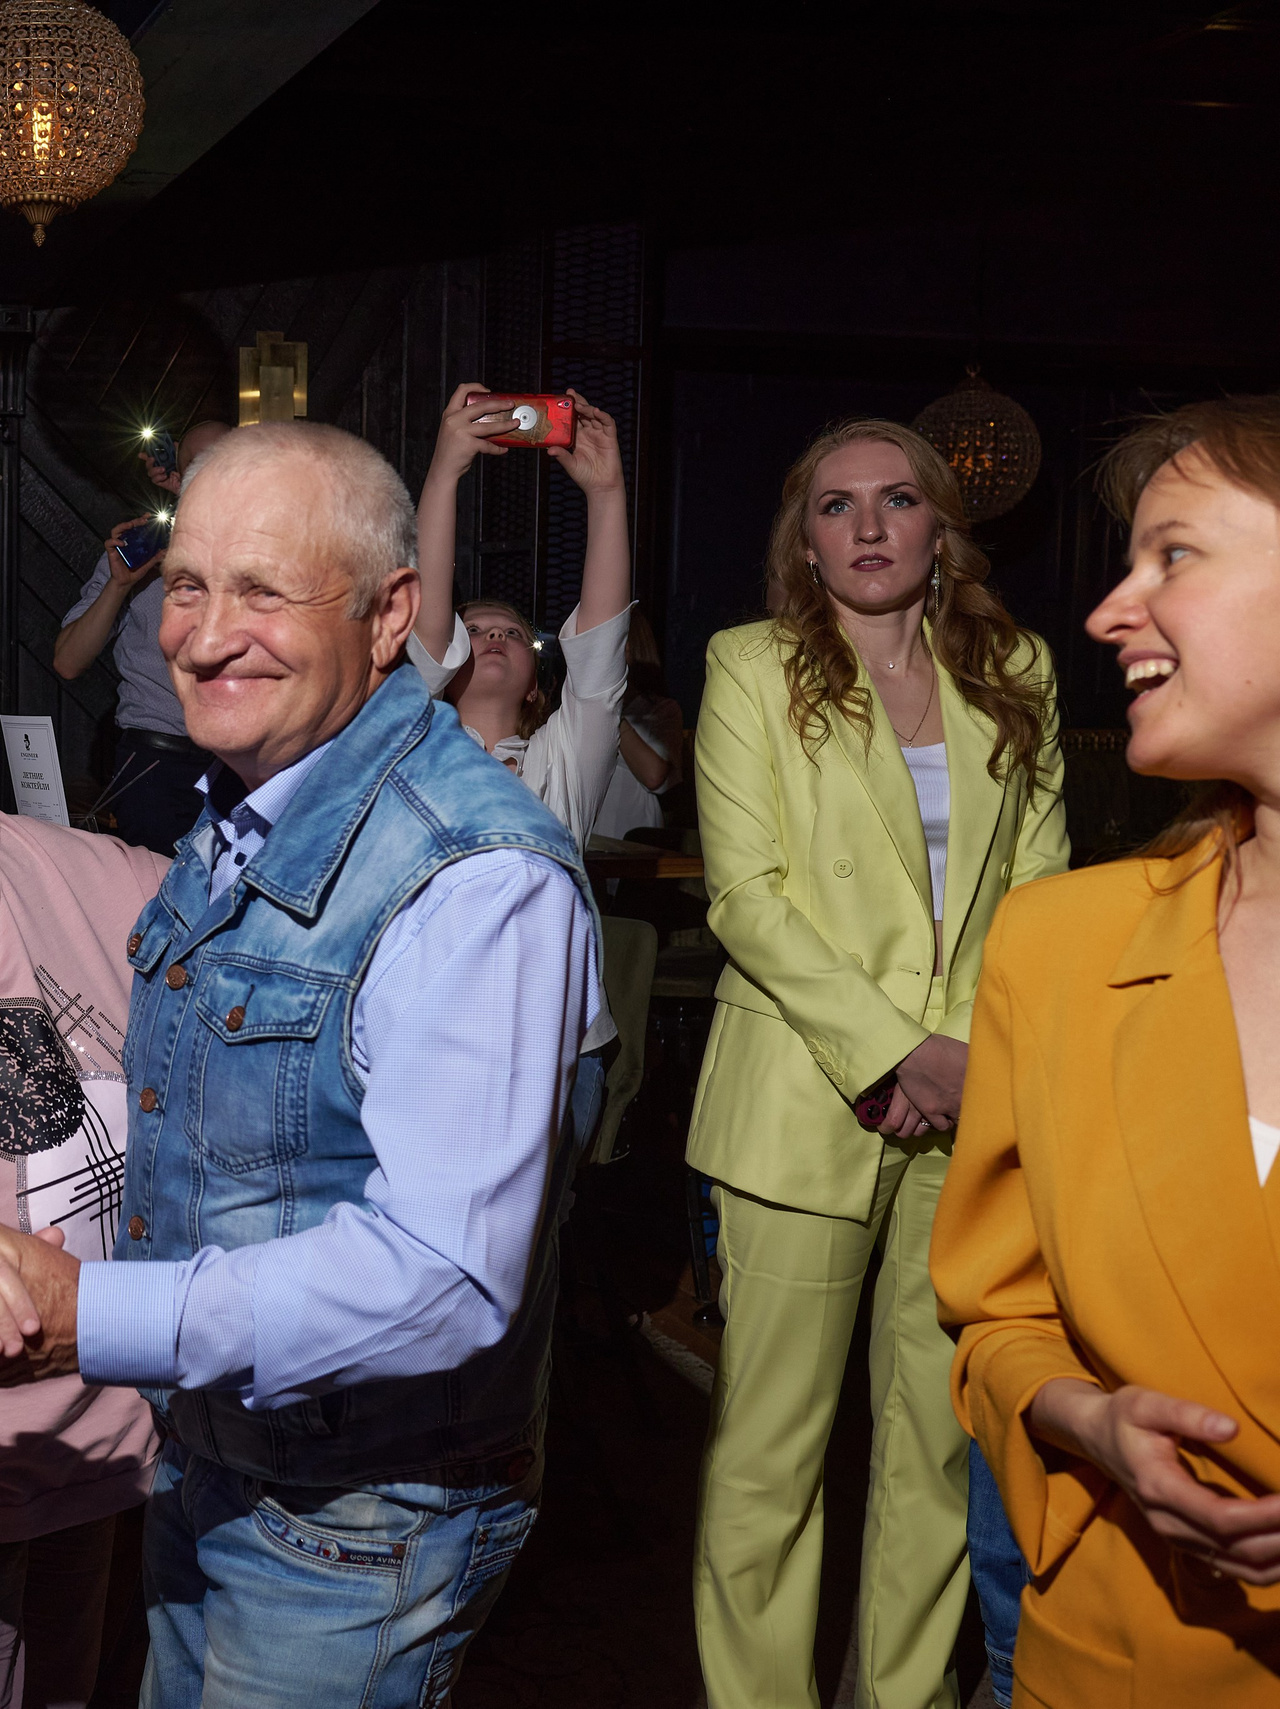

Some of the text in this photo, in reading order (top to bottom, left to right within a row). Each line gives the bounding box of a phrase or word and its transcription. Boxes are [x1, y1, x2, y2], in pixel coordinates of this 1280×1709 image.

[22, 771, 45, 780] ЛЕТНИЕ
[20, 781, 50, 791] КОКТЕЙЛИ
[349, 1554, 402, 1565] GOOD AVINA
